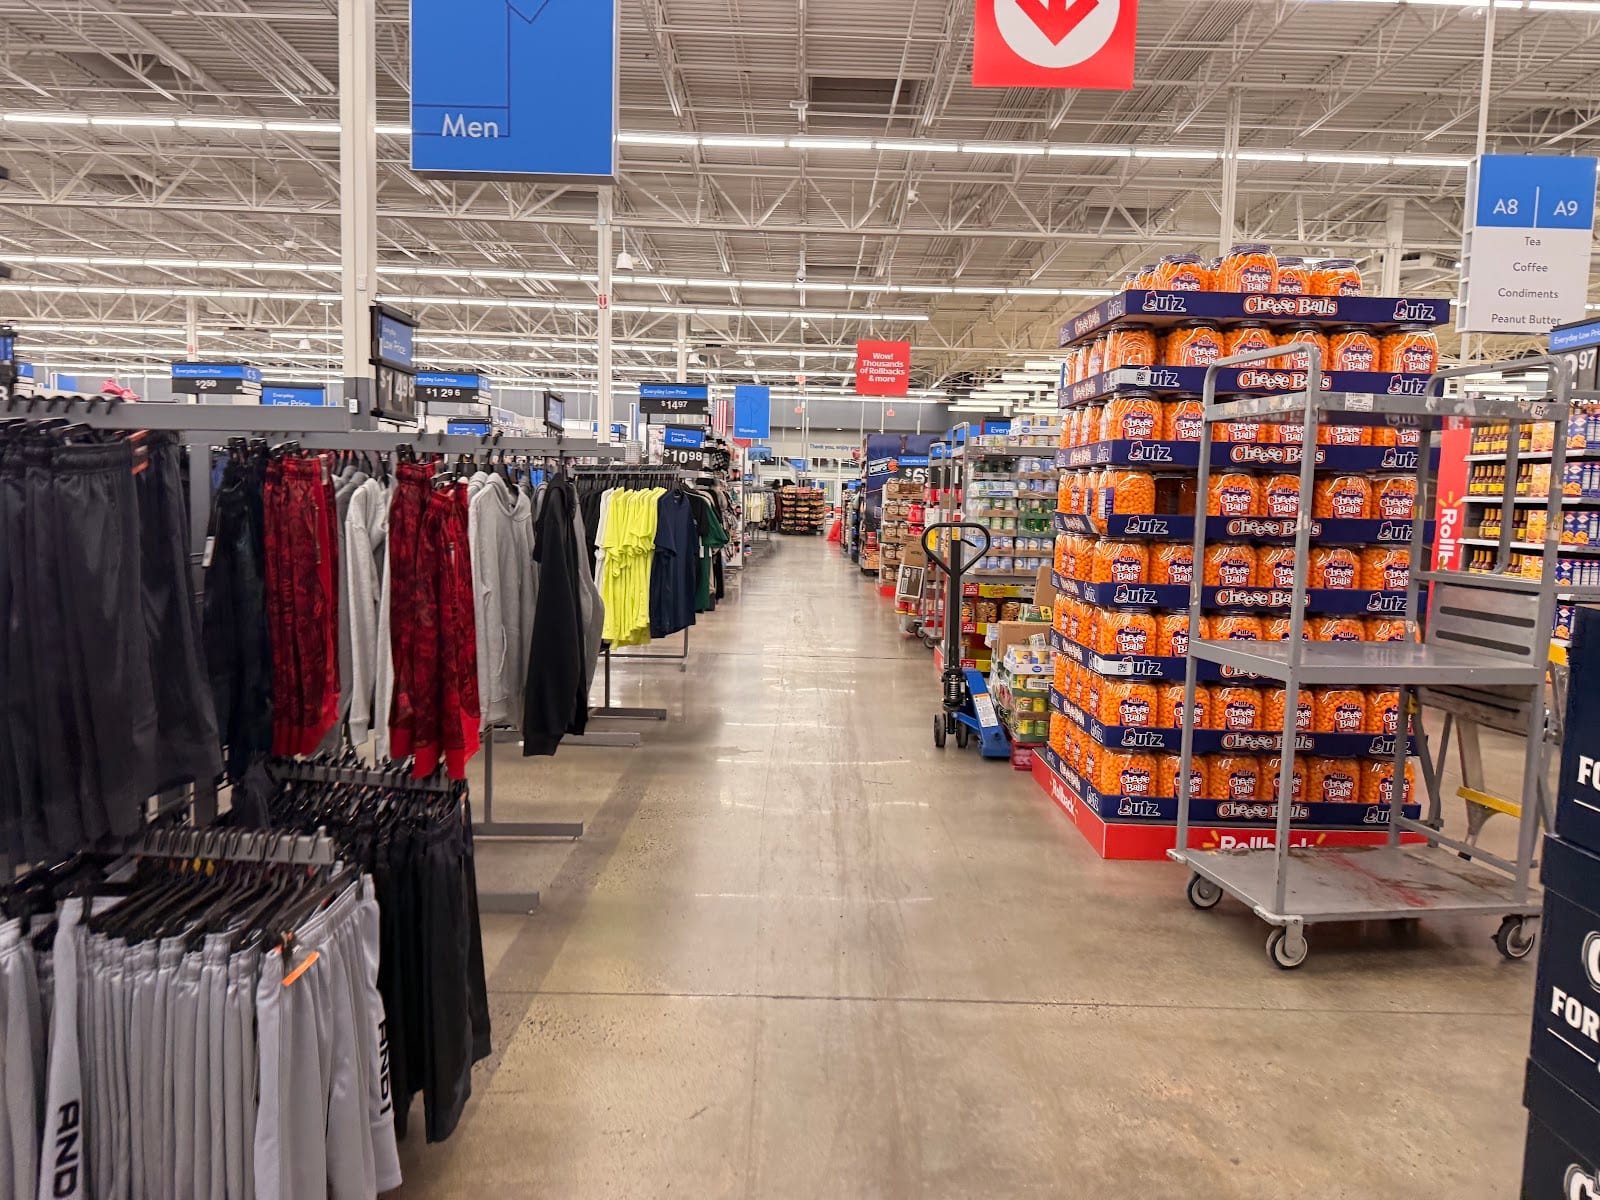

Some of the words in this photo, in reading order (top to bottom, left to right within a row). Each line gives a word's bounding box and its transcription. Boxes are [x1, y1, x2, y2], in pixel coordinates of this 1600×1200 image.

[441, 113, 499, 138] Men
[1493, 198, 1518, 214] A8
[1553, 200, 1578, 216] A9
[1525, 236, 1541, 246] Tea
[1512, 262, 1549, 273] Coffee
[1241, 272, 1272, 284] Cheese
[1247, 283, 1269, 292] Balls
[1498, 287, 1559, 299] Condiments
[1244, 295, 1296, 314] Cheese
[1297, 297, 1338, 315] Balls
[1491, 313, 1526, 325] Peanut
[1529, 314, 1562, 326] Butter
[1554, 334, 1578, 345] Everyday
[1579, 331, 1590, 340] Low
[872, 352, 894, 360] Wow!
[1189, 347, 1219, 358] Cheese
[1341, 352, 1373, 363] Cheese
[1403, 352, 1433, 363] Cheese
[862, 359, 904, 368] Thousands
[1348, 361, 1370, 371] Balls
[1409, 361, 1430, 372] Balls
[869, 367, 906, 375] Rollbacks
[1239, 371, 1290, 389] Cheese
[1121, 417, 1154, 428] Cheese
[1127, 426, 1151, 437] Balls
[1233, 430, 1257, 440] Balls
[1335, 433, 1360, 444] Balls
[1232, 445, 1284, 463] Cheese
[1219, 493, 1251, 504] Cheese
[1331, 496, 1364, 507] Cheese
[1379, 497, 1413, 508] Cheese
[1225, 502, 1248, 512] Balls
[1273, 503, 1297, 514] Balls
[1338, 505, 1361, 515] Balls
[1385, 506, 1409, 517] Balls
[1228, 520, 1280, 536] Cheese
[1110, 563, 1142, 574] Cheese
[1218, 566, 1250, 577] Cheese
[1323, 568, 1354, 579] Cheese
[1116, 571, 1139, 582] Balls
[1224, 574, 1248, 584] Balls
[1329, 577, 1351, 588] Balls
[1217, 590, 1269, 606] Cheese
[1115, 633, 1147, 645] Cheese
[1121, 642, 1144, 652] Balls
[1118, 705, 1150, 716] Cheese
[1225, 708, 1256, 719] Cheese
[1333, 711, 1364, 721] Cheese
[1124, 713, 1147, 723] Balls
[1230, 717, 1252, 727] Balls
[1339, 719, 1360, 729] Balls
[1222, 735, 1273, 750] Cheese
[1120, 775, 1150, 786] Cheese
[1228, 776, 1257, 788] Cheese
[1322, 779, 1354, 791] Cheese
[1126, 783, 1148, 793] Balls
[1234, 784, 1254, 795] Balls
[1328, 787, 1351, 798] Balls
[1218, 803, 1268, 819] Cheese
